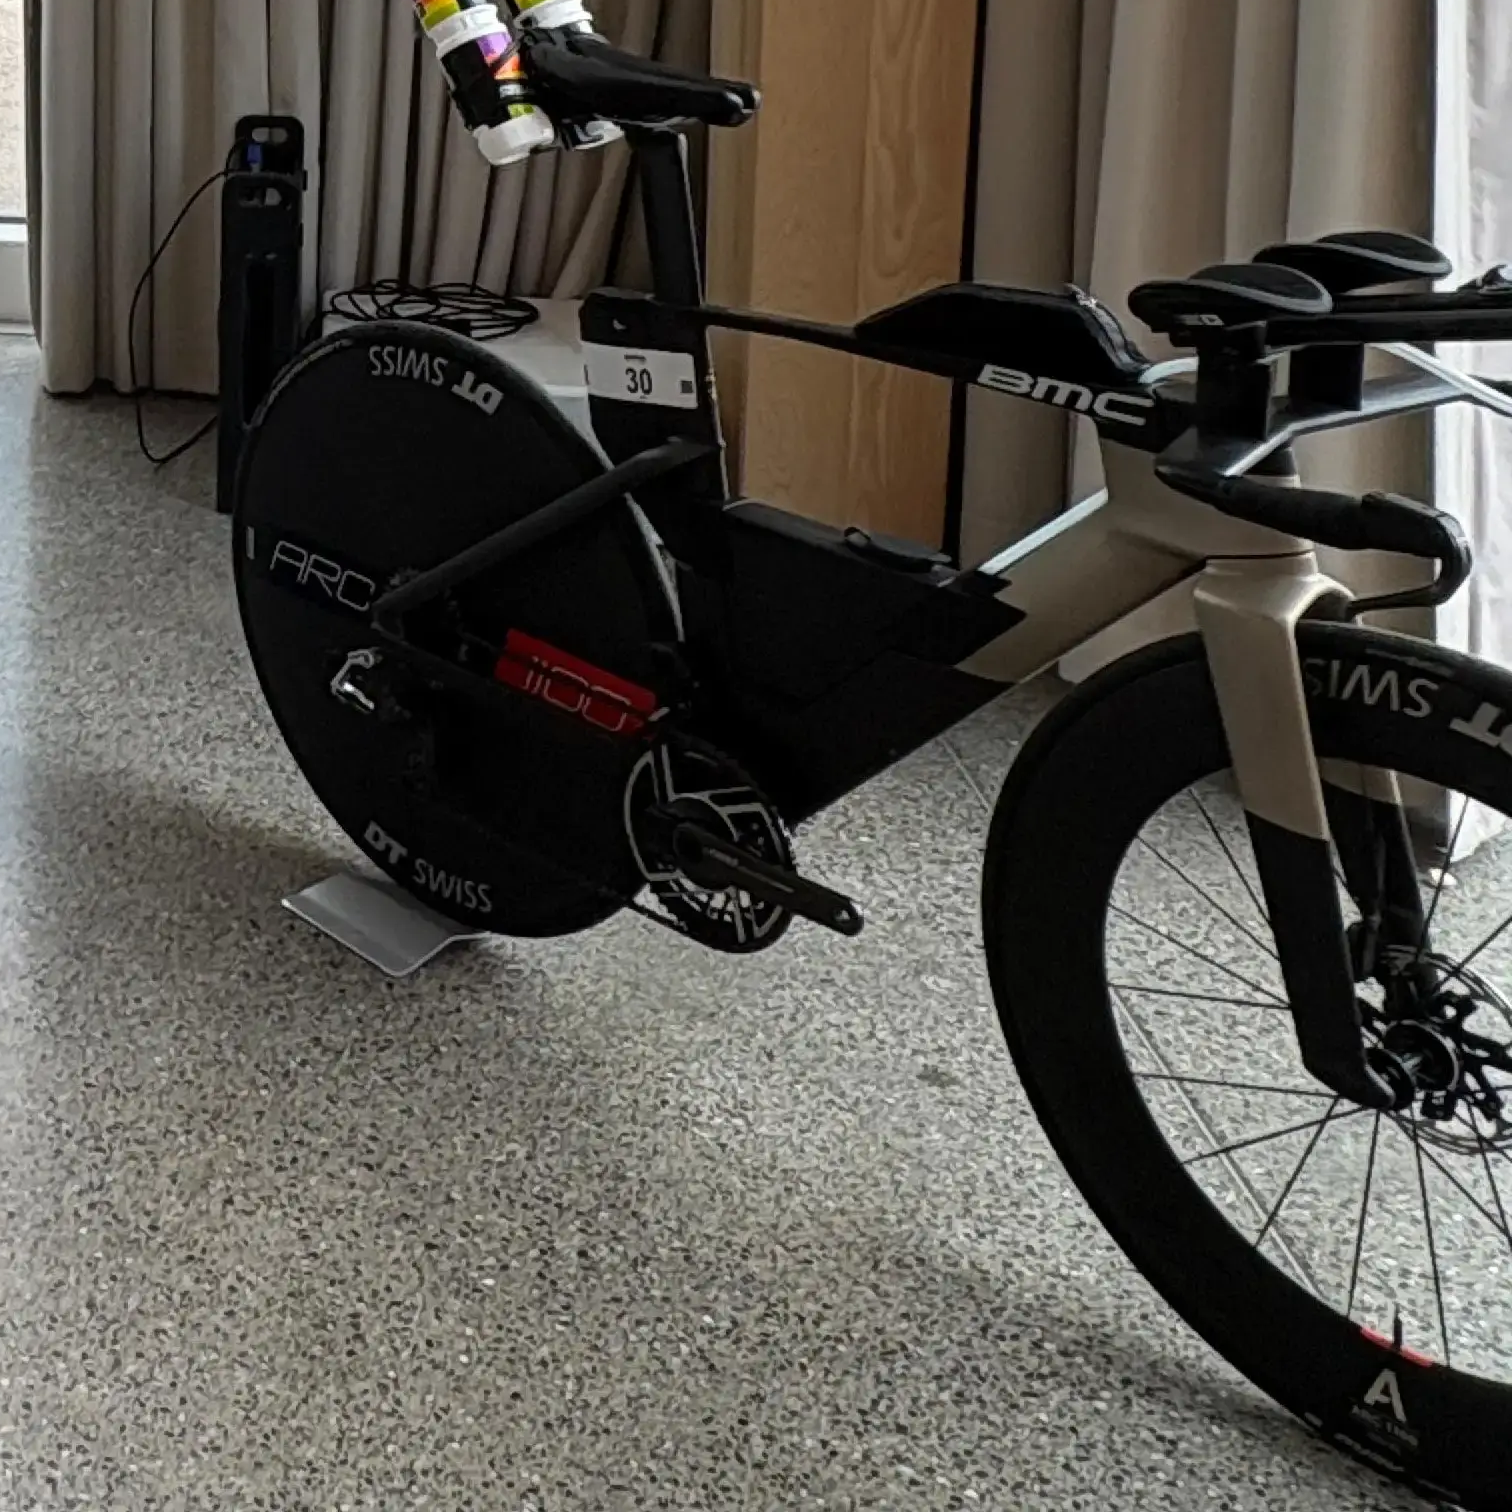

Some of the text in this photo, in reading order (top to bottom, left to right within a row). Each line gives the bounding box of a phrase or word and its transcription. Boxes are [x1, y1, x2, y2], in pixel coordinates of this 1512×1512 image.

[367, 345, 505, 416] DT SWISS
[625, 367, 653, 395] 30
[976, 362, 1156, 427] BMC
[269, 540, 377, 613] ARC
[1303, 656, 1440, 719] SWIS
[363, 820, 493, 912] DT SWISS
